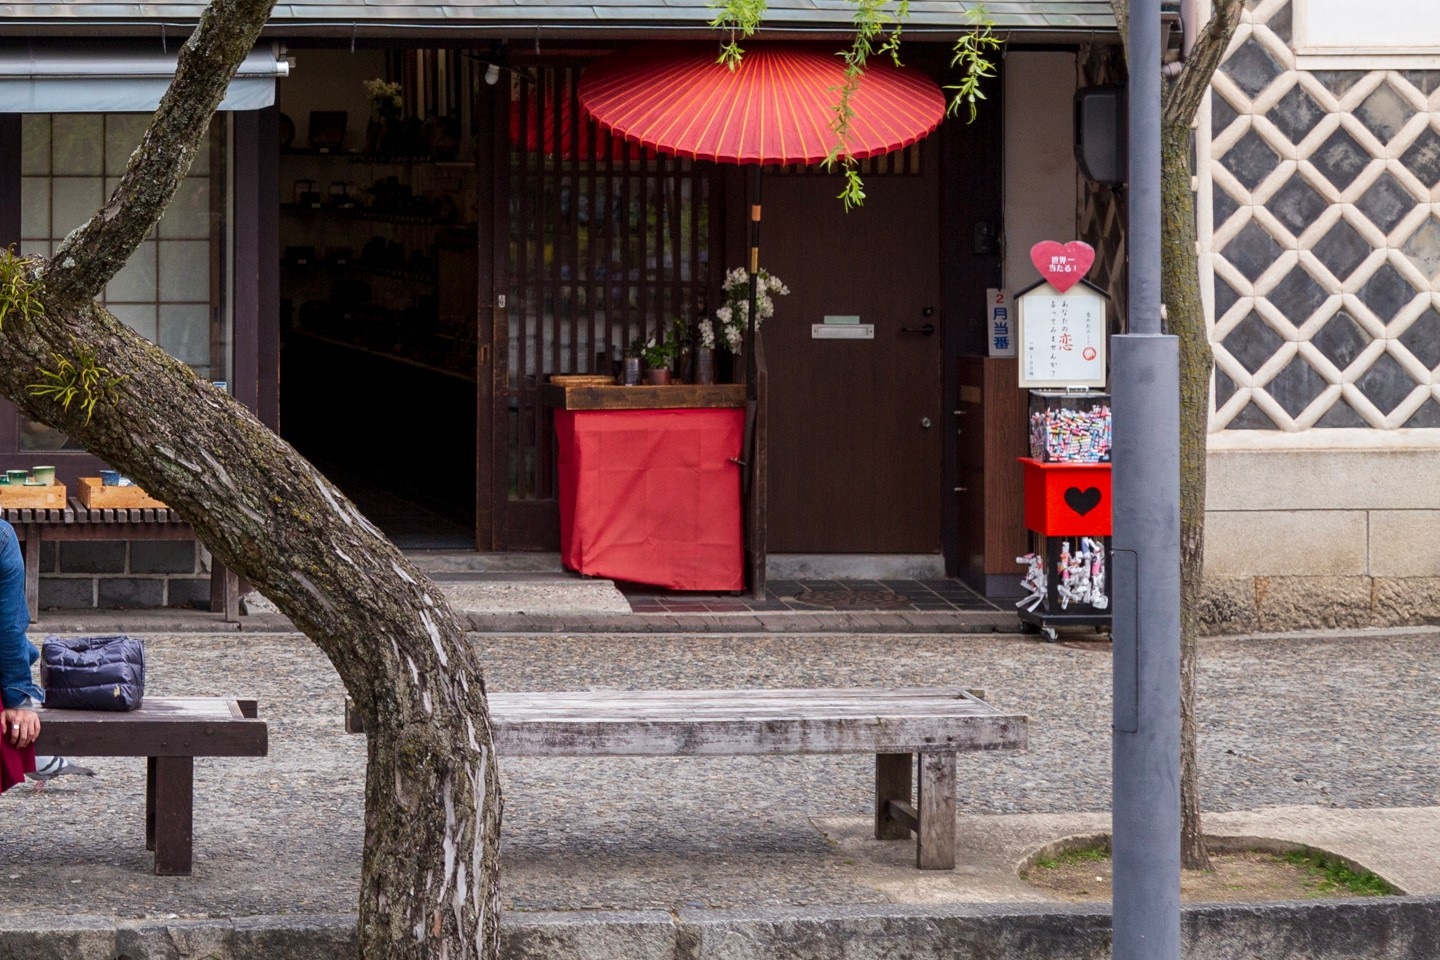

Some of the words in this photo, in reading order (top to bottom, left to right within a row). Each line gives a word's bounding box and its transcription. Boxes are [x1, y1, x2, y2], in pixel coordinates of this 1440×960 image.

[1051, 256, 1075, 264] 世界一
[993, 293, 1010, 349] 2月当番
[1059, 301, 1073, 351] あなたの恋
